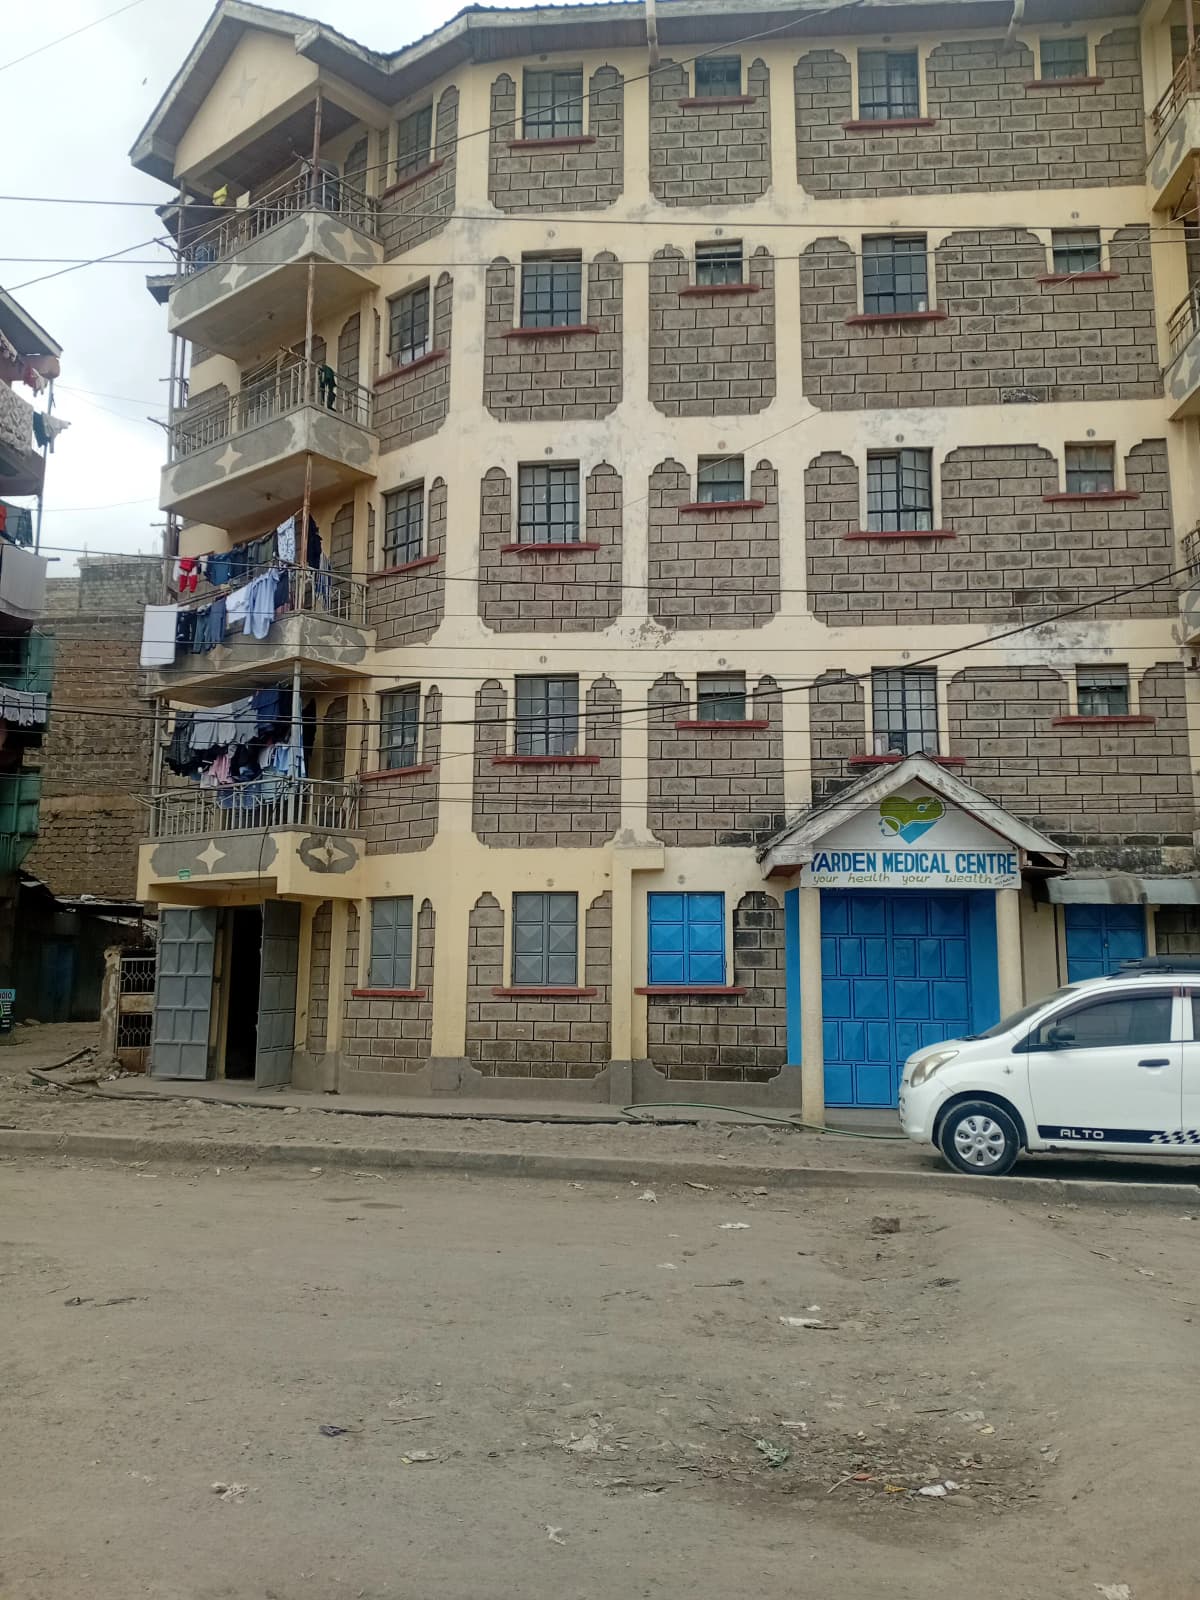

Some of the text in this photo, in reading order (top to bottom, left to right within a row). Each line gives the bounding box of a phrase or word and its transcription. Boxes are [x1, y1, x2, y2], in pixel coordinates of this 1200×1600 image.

[811, 852, 1017, 875] YARDEN MEDICAL CENTRE
[813, 875, 839, 886] your
[848, 873, 890, 883] health
[902, 875, 930, 886] your
[1060, 1128, 1104, 1140] ALTO
